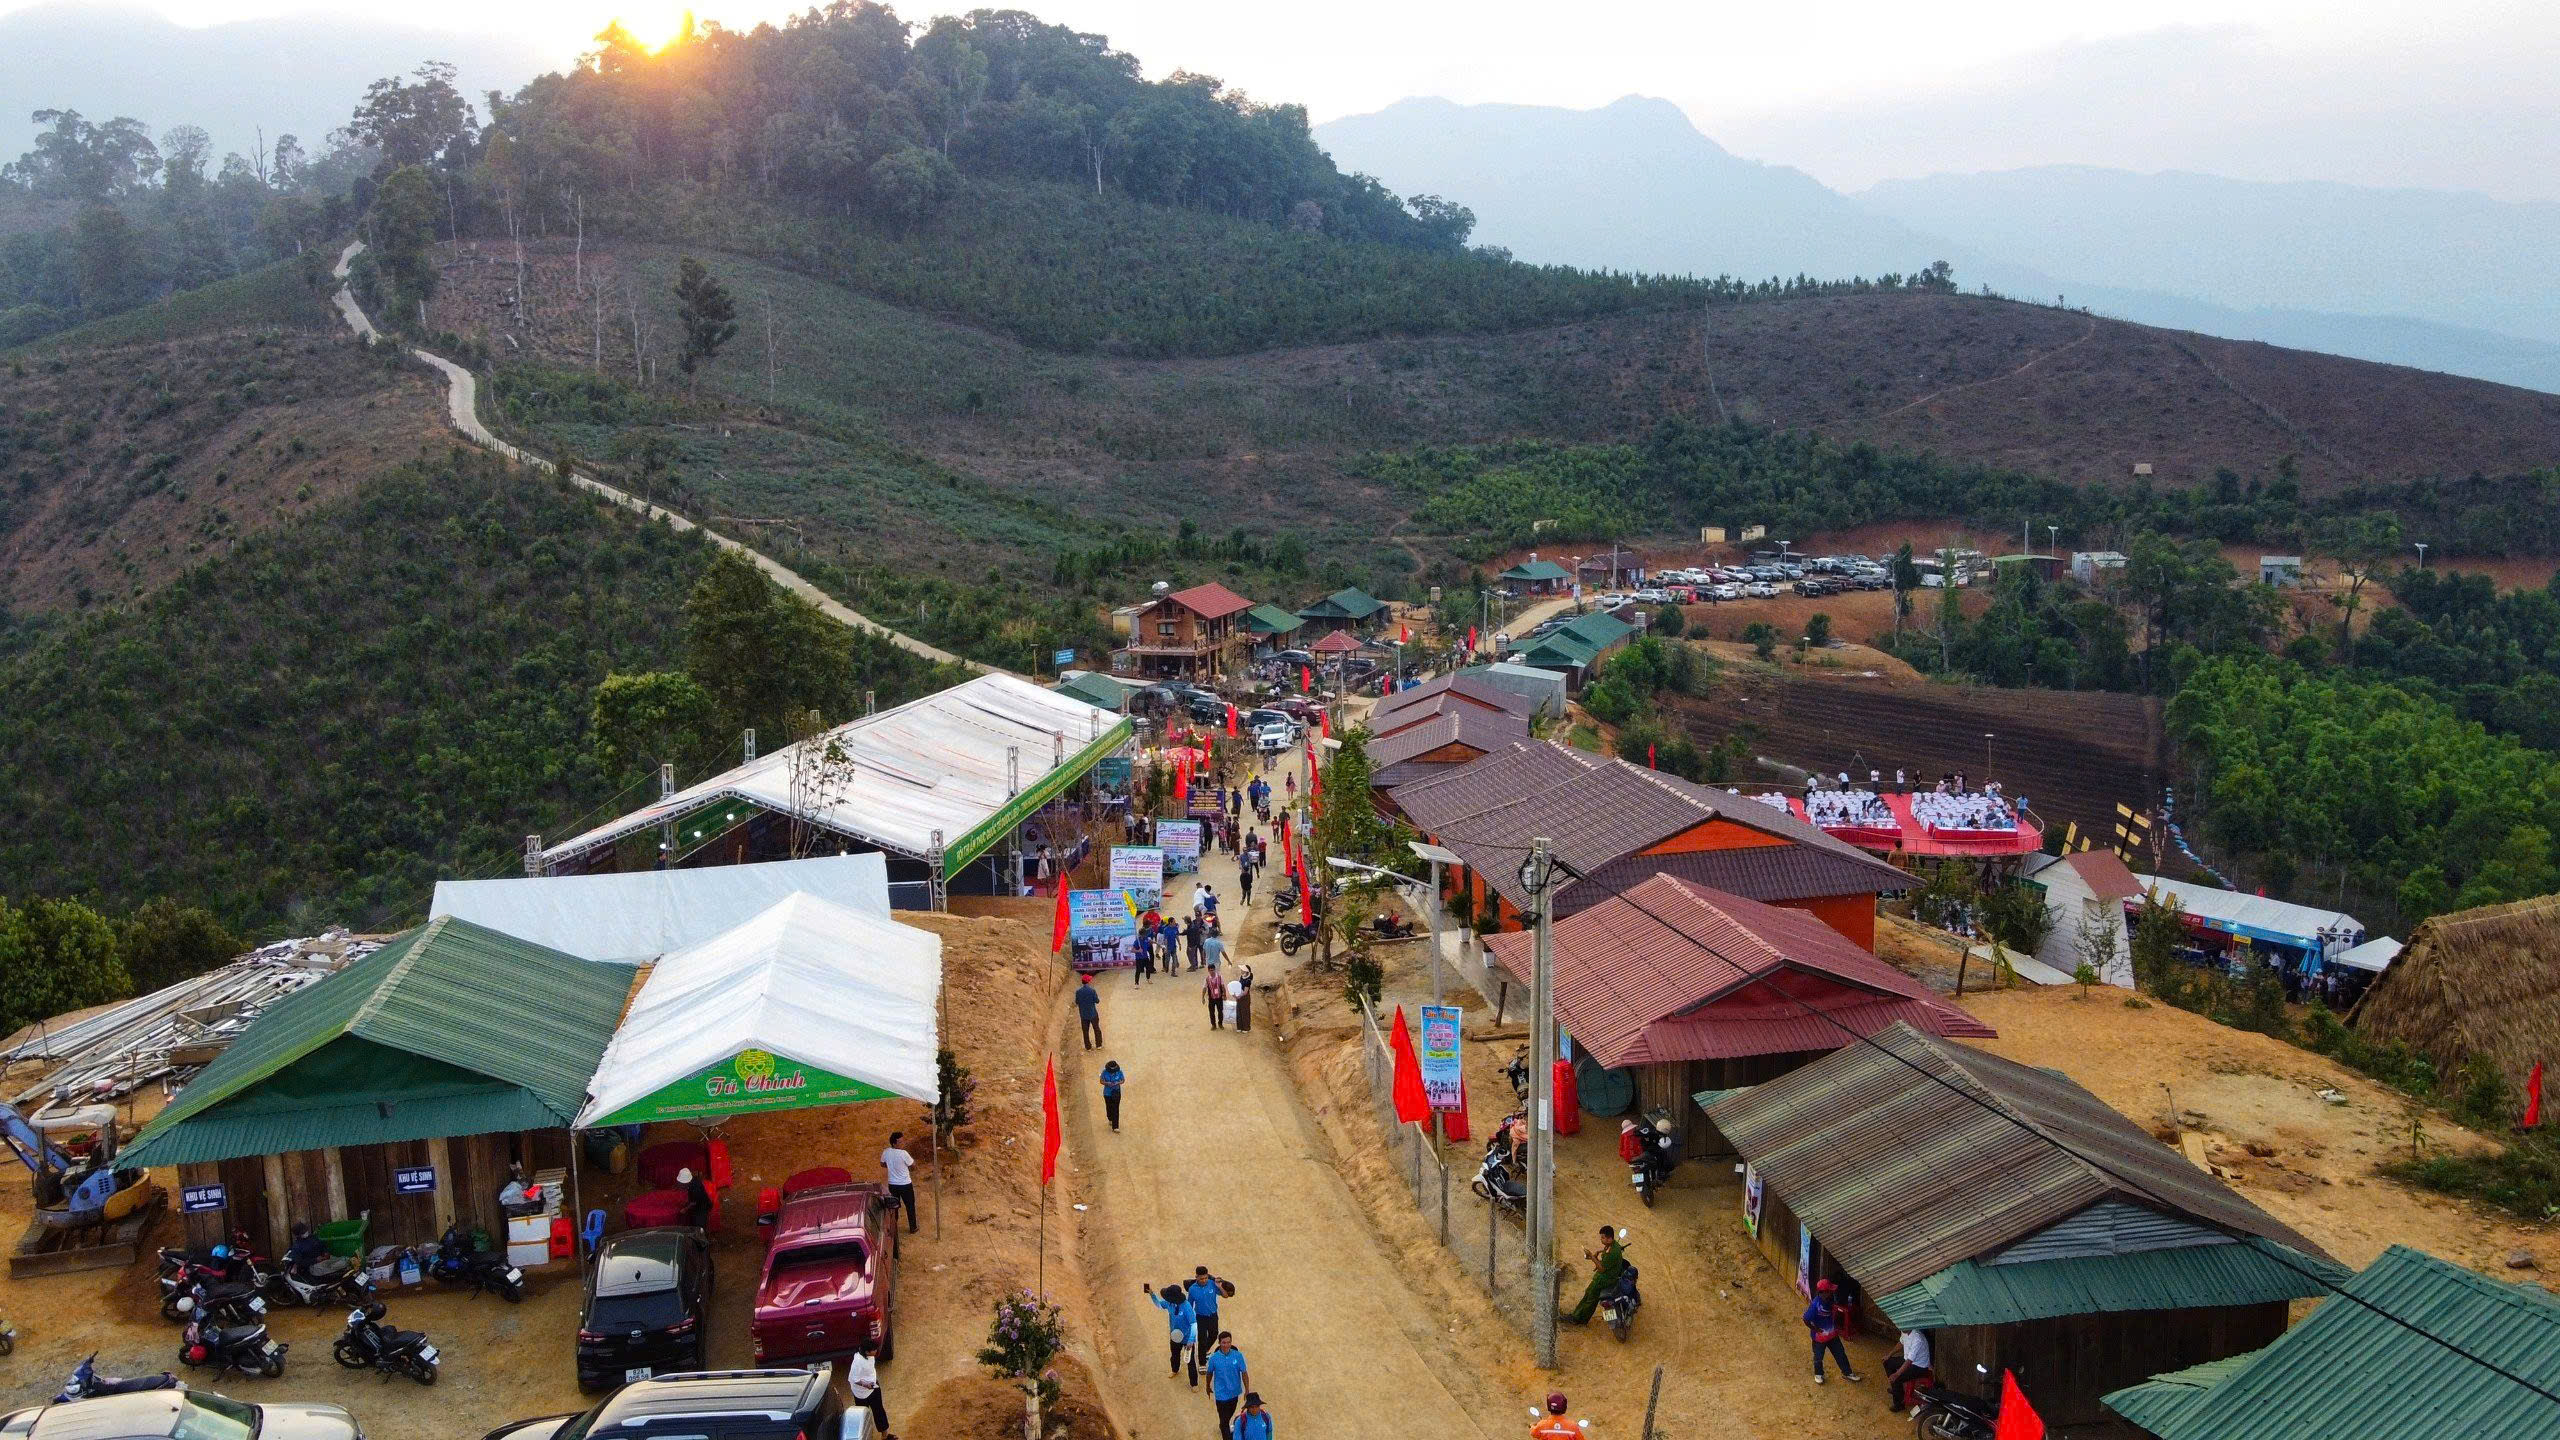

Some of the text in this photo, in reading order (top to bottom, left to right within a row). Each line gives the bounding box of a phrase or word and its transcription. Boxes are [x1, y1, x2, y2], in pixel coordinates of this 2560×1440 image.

[398, 1171, 433, 1183] KHU VỆ SINH
[185, 1189, 222, 1202] KHU VỆ SINH
